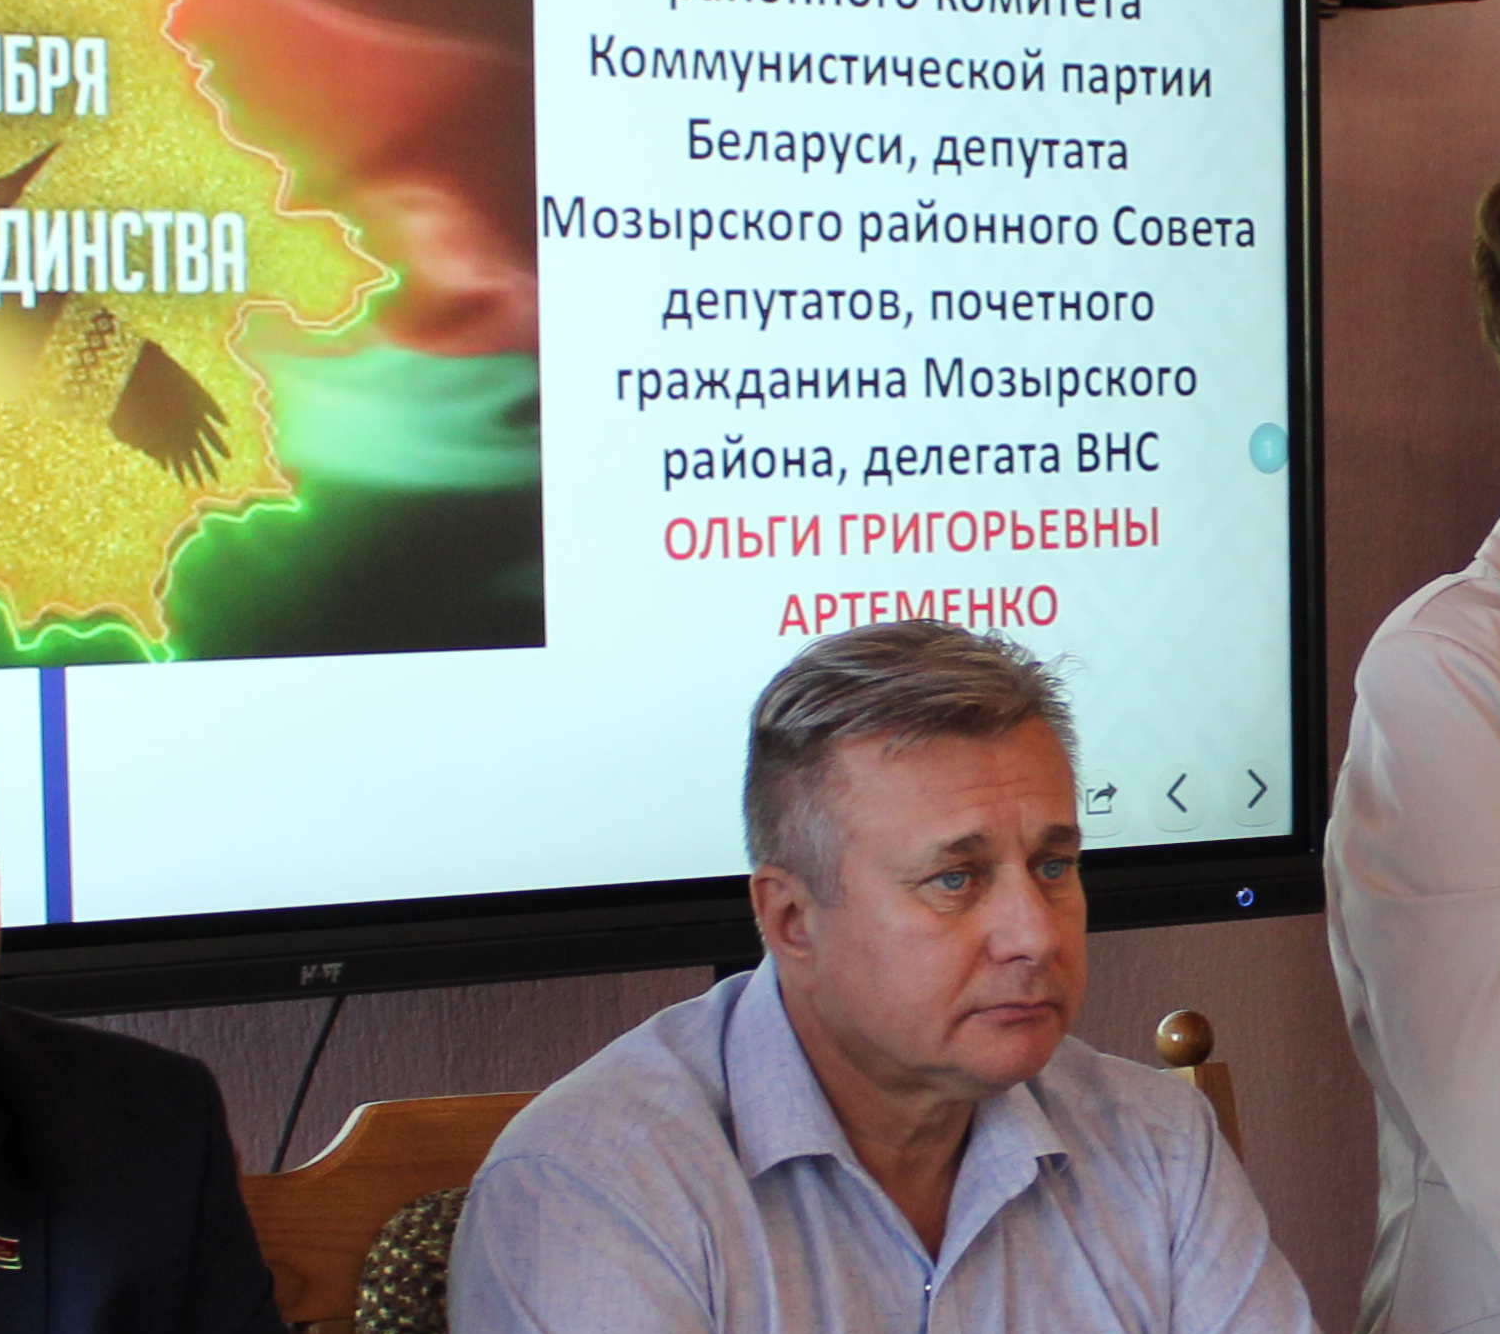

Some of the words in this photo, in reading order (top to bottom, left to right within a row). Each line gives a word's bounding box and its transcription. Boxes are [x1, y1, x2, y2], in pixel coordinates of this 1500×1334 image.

[588, 33, 1046, 95] Коммунистической
[1061, 61, 1214, 105] партии
[688, 118, 918, 176] Беларуси,
[933, 129, 1130, 179] депутата
[541, 195, 844, 250] Мозырского
[859, 199, 1100, 252] районного
[1111, 205, 1258, 249] Совета
[661, 285, 915, 331] депутатов,
[930, 285, 1156, 324] почетного
[615, 364, 908, 411] гражданина
[923, 357, 1199, 407] Мозырского
[663, 435, 849, 491] района,
[863, 441, 1061, 487] делегата
[1076, 431, 1162, 474] ВНС
[663, 513, 823, 563] ОЛЬГИ
[837, 506, 1162, 556] ГРИГОРЬЕВНЫ
[777, 583, 1060, 637] АРТЕМЕНКО
